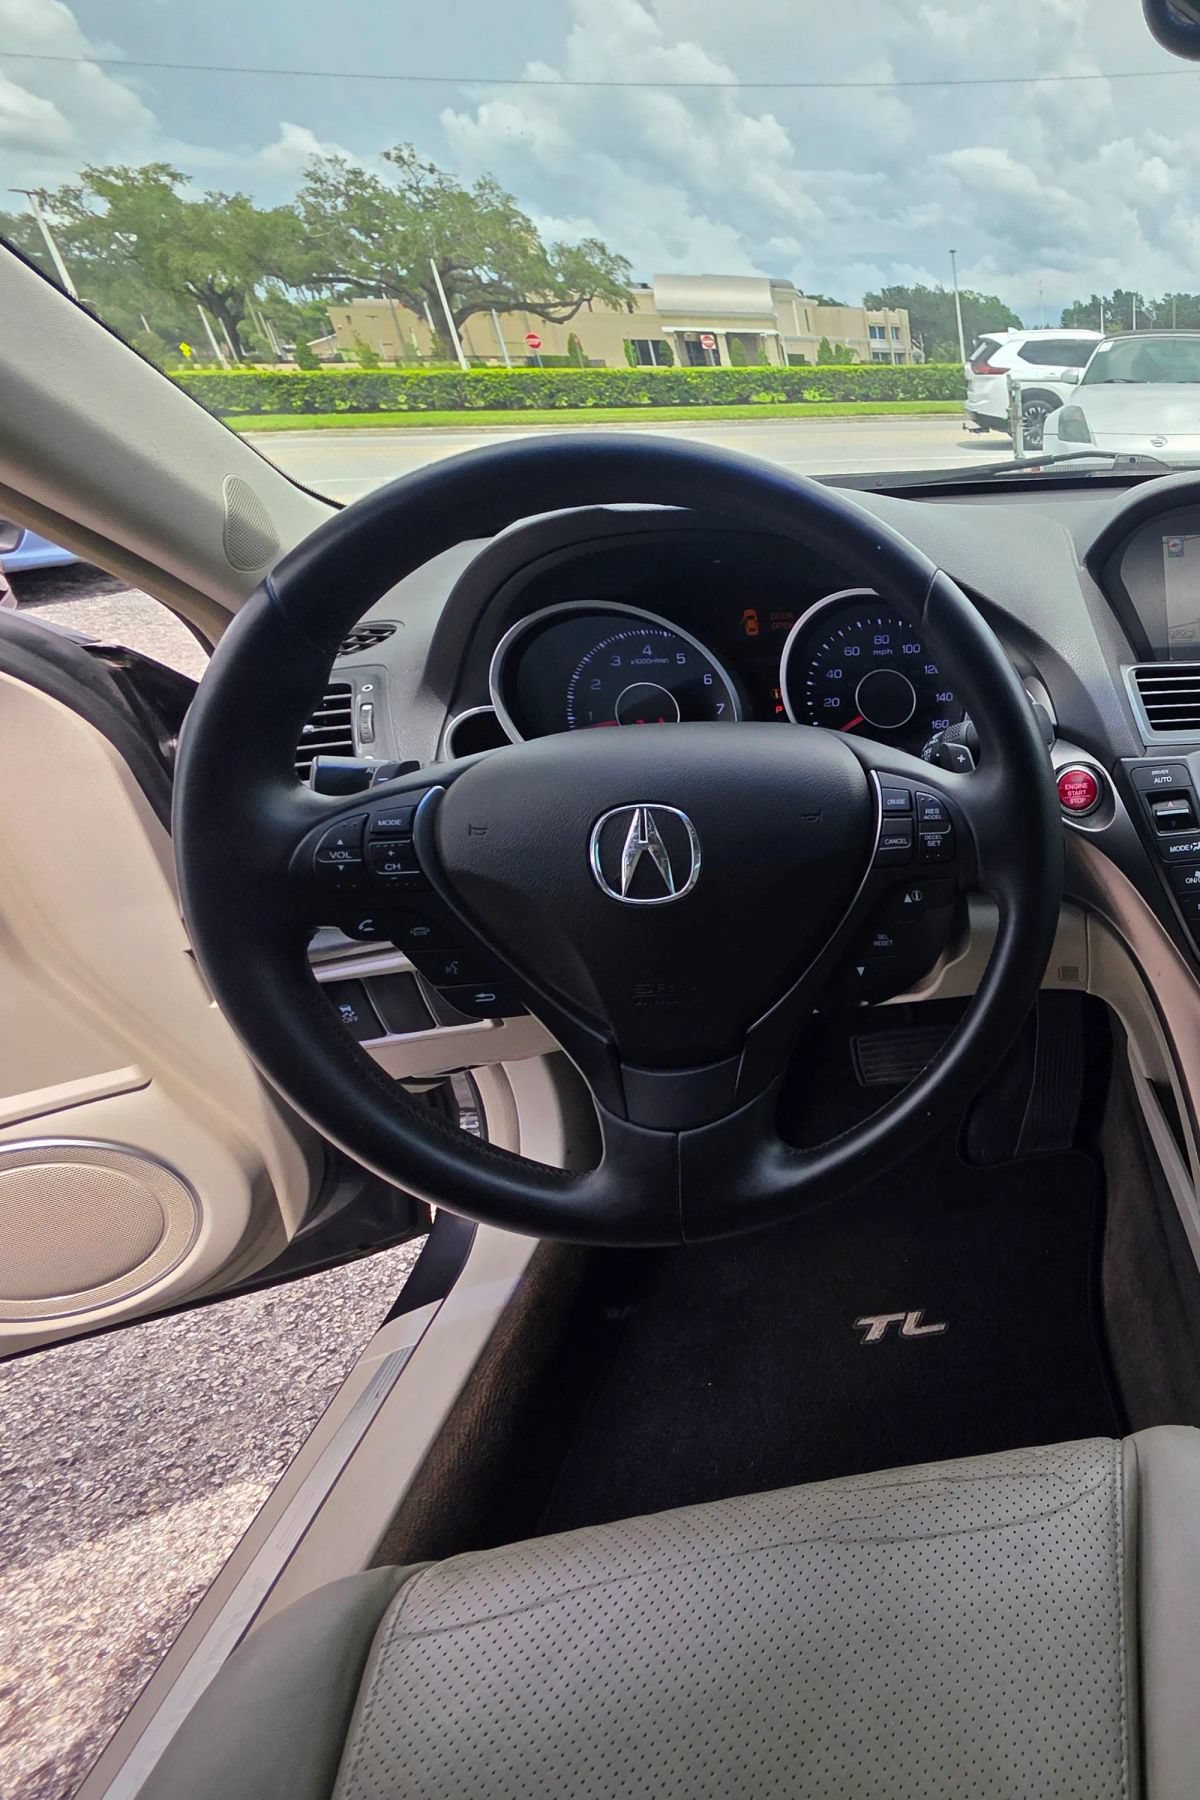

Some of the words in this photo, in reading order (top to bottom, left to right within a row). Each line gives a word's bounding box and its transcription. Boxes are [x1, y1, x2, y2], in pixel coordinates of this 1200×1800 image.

[873, 634, 889, 644] 80
[642, 644, 653, 656] 4
[844, 646, 860, 656] 60
[873, 648, 893, 656] mph
[902, 643, 920, 654] 100
[610, 655, 621, 666] 3
[675, 653, 686, 664] 5
[826, 669, 842, 679] 40
[590, 679, 601, 690] 2
[703, 674, 712, 685] 6
[823, 697, 840, 707] 20
[935, 692, 953, 702] 140
[716, 703, 725, 715] 7
[588, 711, 593, 720] 1
[931, 719, 949, 729] 160
[1153, 776, 1172, 784] AUTO
[1065, 782, 1088, 790] ENGINE
[1169, 844, 1190, 852] MODE
[329, 851, 352, 859] VOL
[855, 1310, 947, 1343] TL
